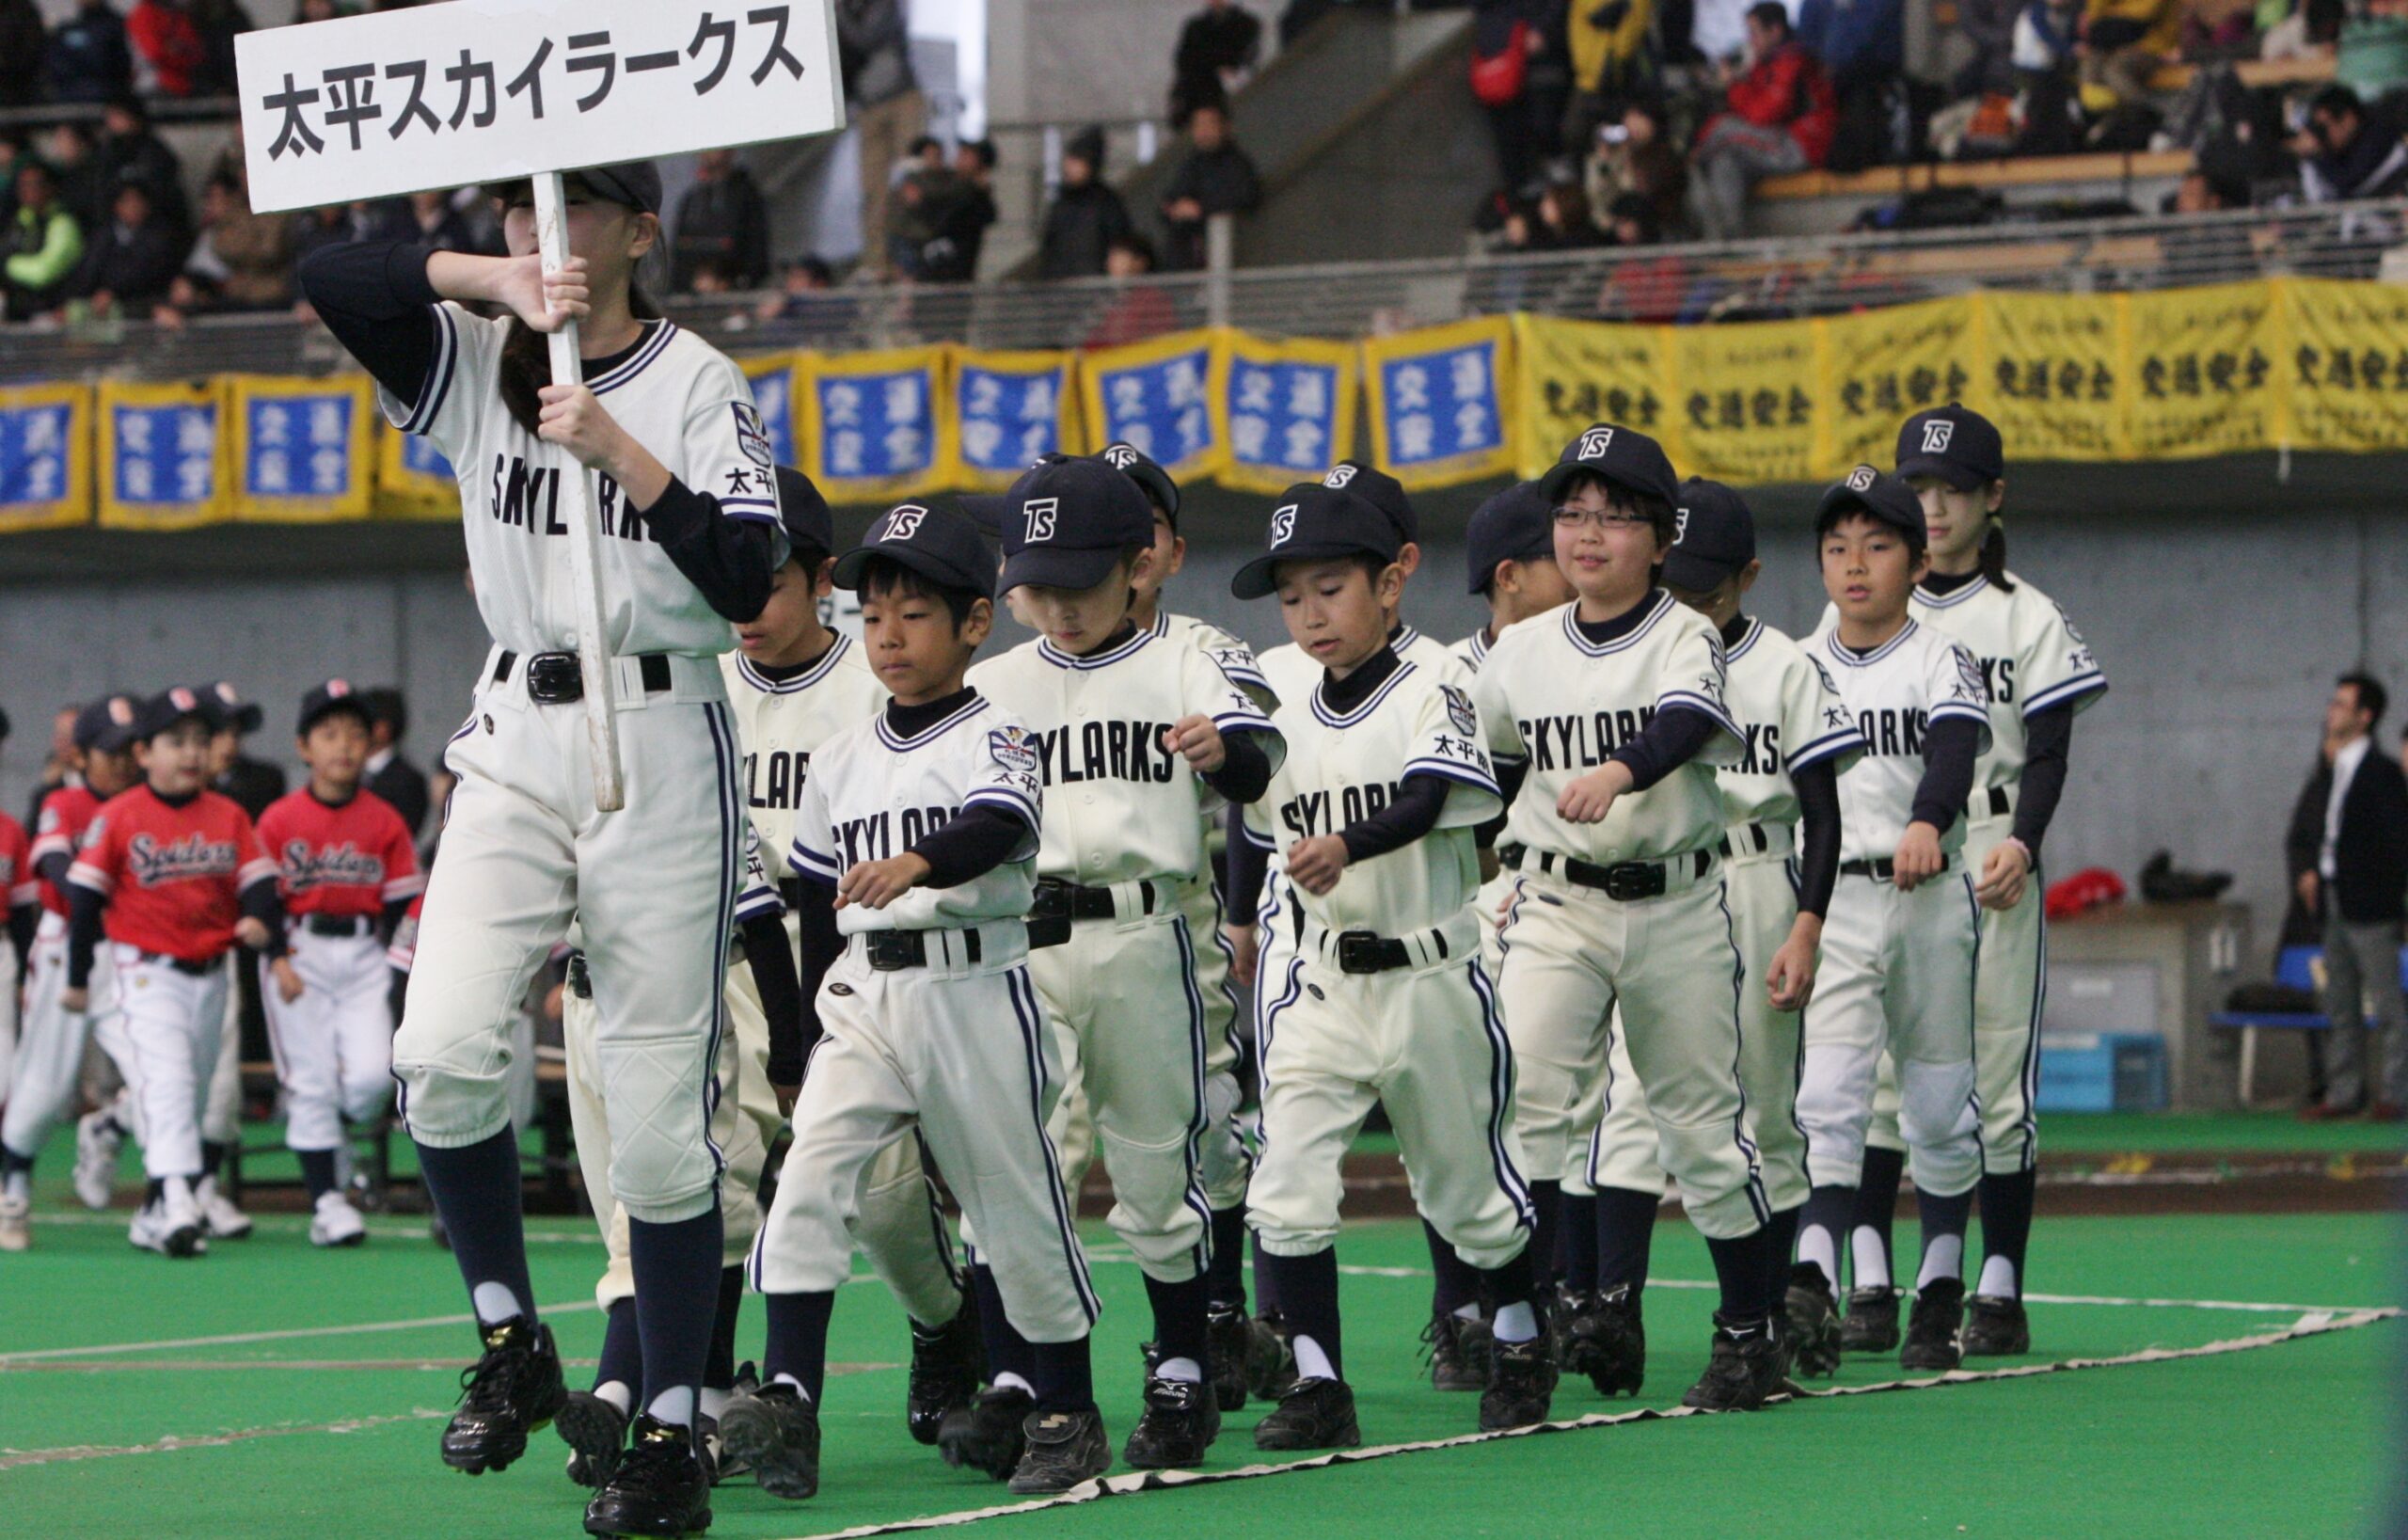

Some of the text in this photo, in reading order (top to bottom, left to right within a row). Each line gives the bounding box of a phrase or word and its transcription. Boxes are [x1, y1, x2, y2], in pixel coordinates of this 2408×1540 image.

[262, 5, 805, 162] 太平スカイラークス
[1578, 428, 1613, 461] TS
[1922, 420, 1954, 453] TS
[879, 504, 928, 542] TS
[1023, 497, 1058, 544] TS
[1271, 504, 1299, 550] TS
